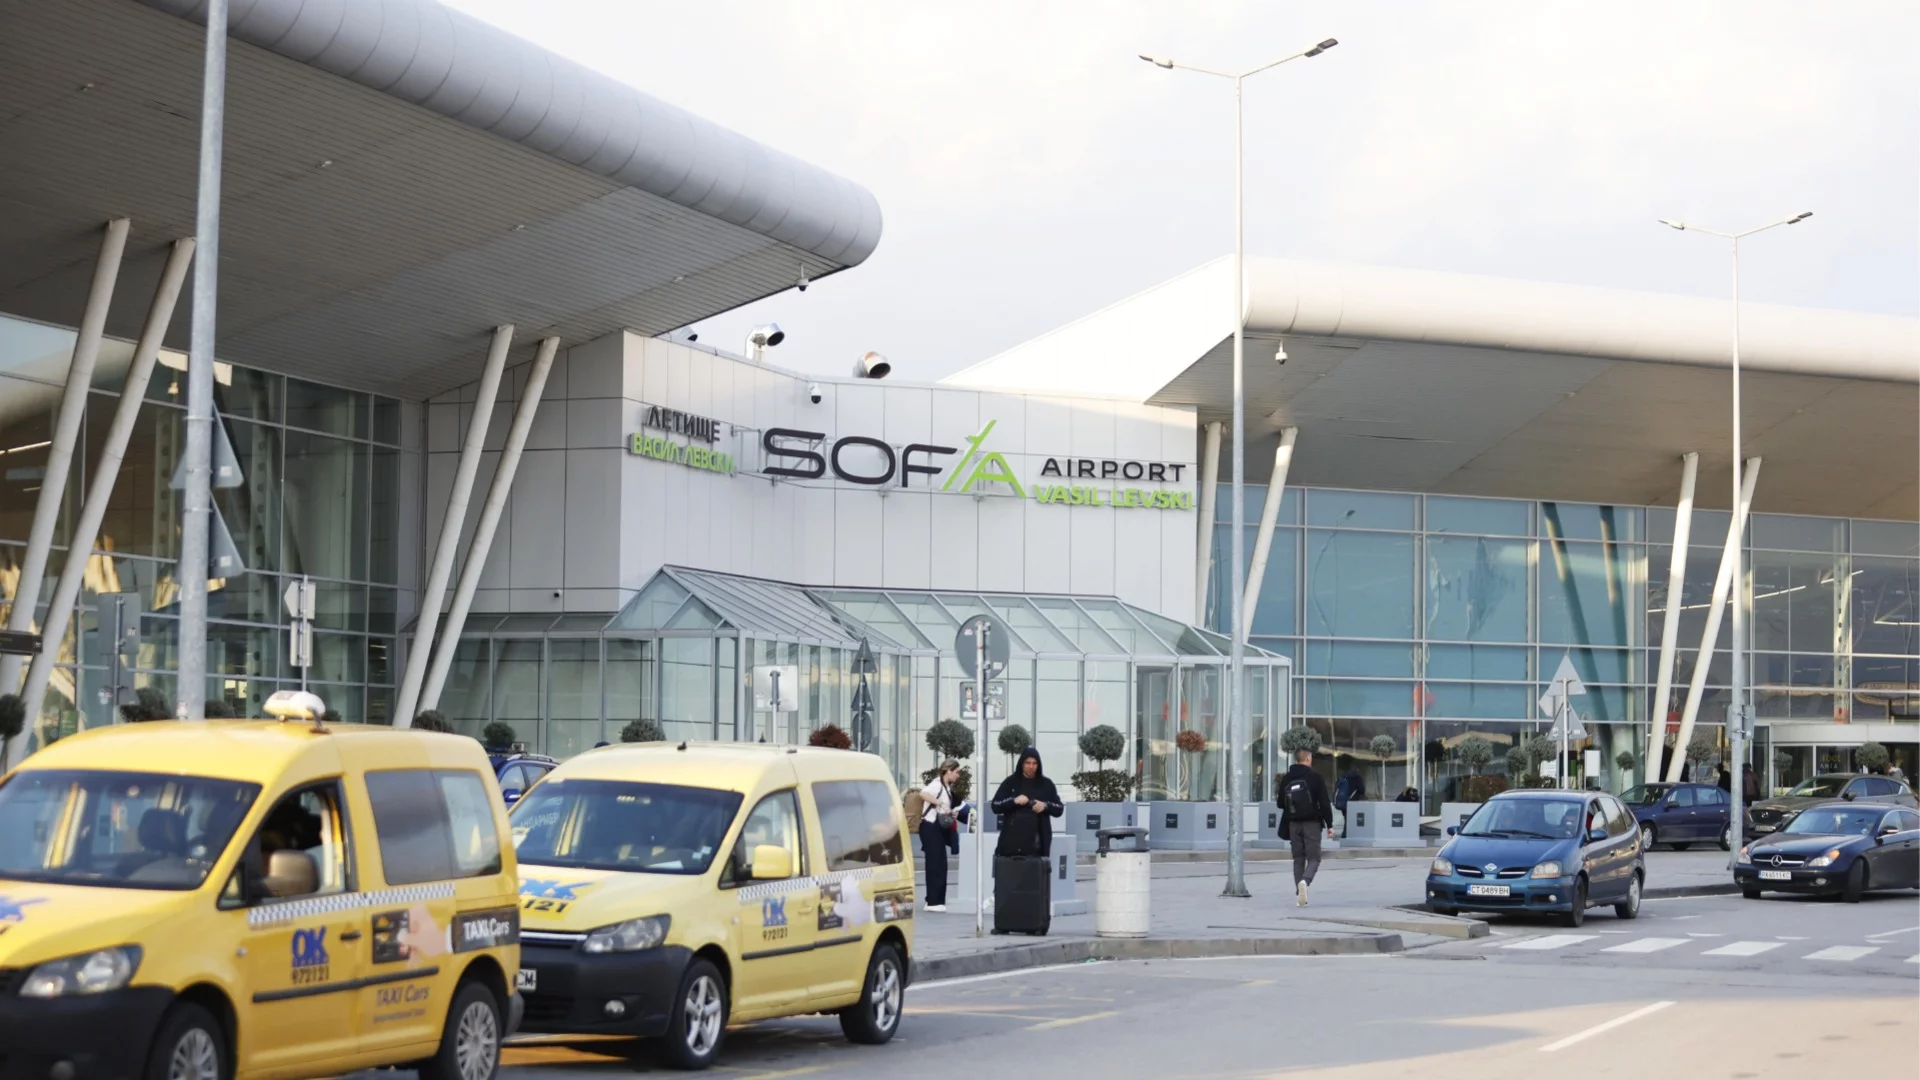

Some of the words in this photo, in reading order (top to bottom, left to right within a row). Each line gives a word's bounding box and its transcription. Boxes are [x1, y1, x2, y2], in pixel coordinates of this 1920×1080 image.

[647, 405, 721, 443] ЛЕТИЩЕ
[631, 432, 680, 465] ВАСИЛ
[683, 444, 735, 475] ЛЕВСКИ
[762, 419, 1027, 500] SOFIA
[1041, 457, 1187, 483] AIRPORT
[1033, 484, 1105, 506] VASIL
[1110, 486, 1193, 511] LEVSKI
[524, 899, 568, 913] 121
[762, 896, 788, 925] OK
[464, 919, 489, 941] TAXI
[490, 917, 510, 937] Cars
[292, 925, 329, 963] OK
[377, 986, 404, 1006] TAXI
[405, 984, 431, 1002] Cars
